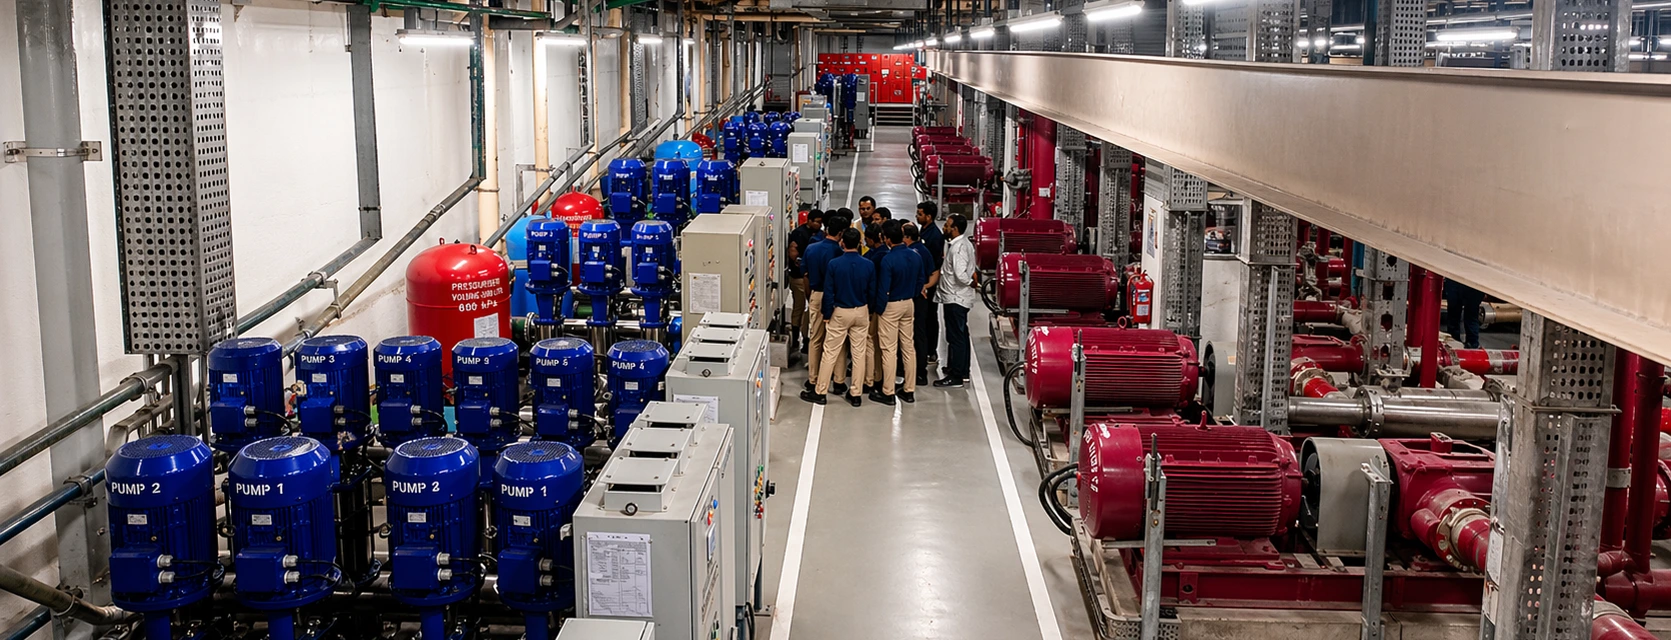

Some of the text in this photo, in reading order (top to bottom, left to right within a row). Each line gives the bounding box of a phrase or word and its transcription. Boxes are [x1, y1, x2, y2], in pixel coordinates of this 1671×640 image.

[301, 354, 336, 364] PUMP 3
[378, 354, 412, 364] PUMP 4
[456, 355, 481, 365] PUMP
[535, 356, 560, 366] PUMP
[612, 360, 636, 370] PUMP
[111, 481, 161, 495] PUMP 2
[235, 482, 284, 496] PUMP 1
[392, 480, 440, 494] PUMP 2
[500, 483, 547, 498] PUMP 1
